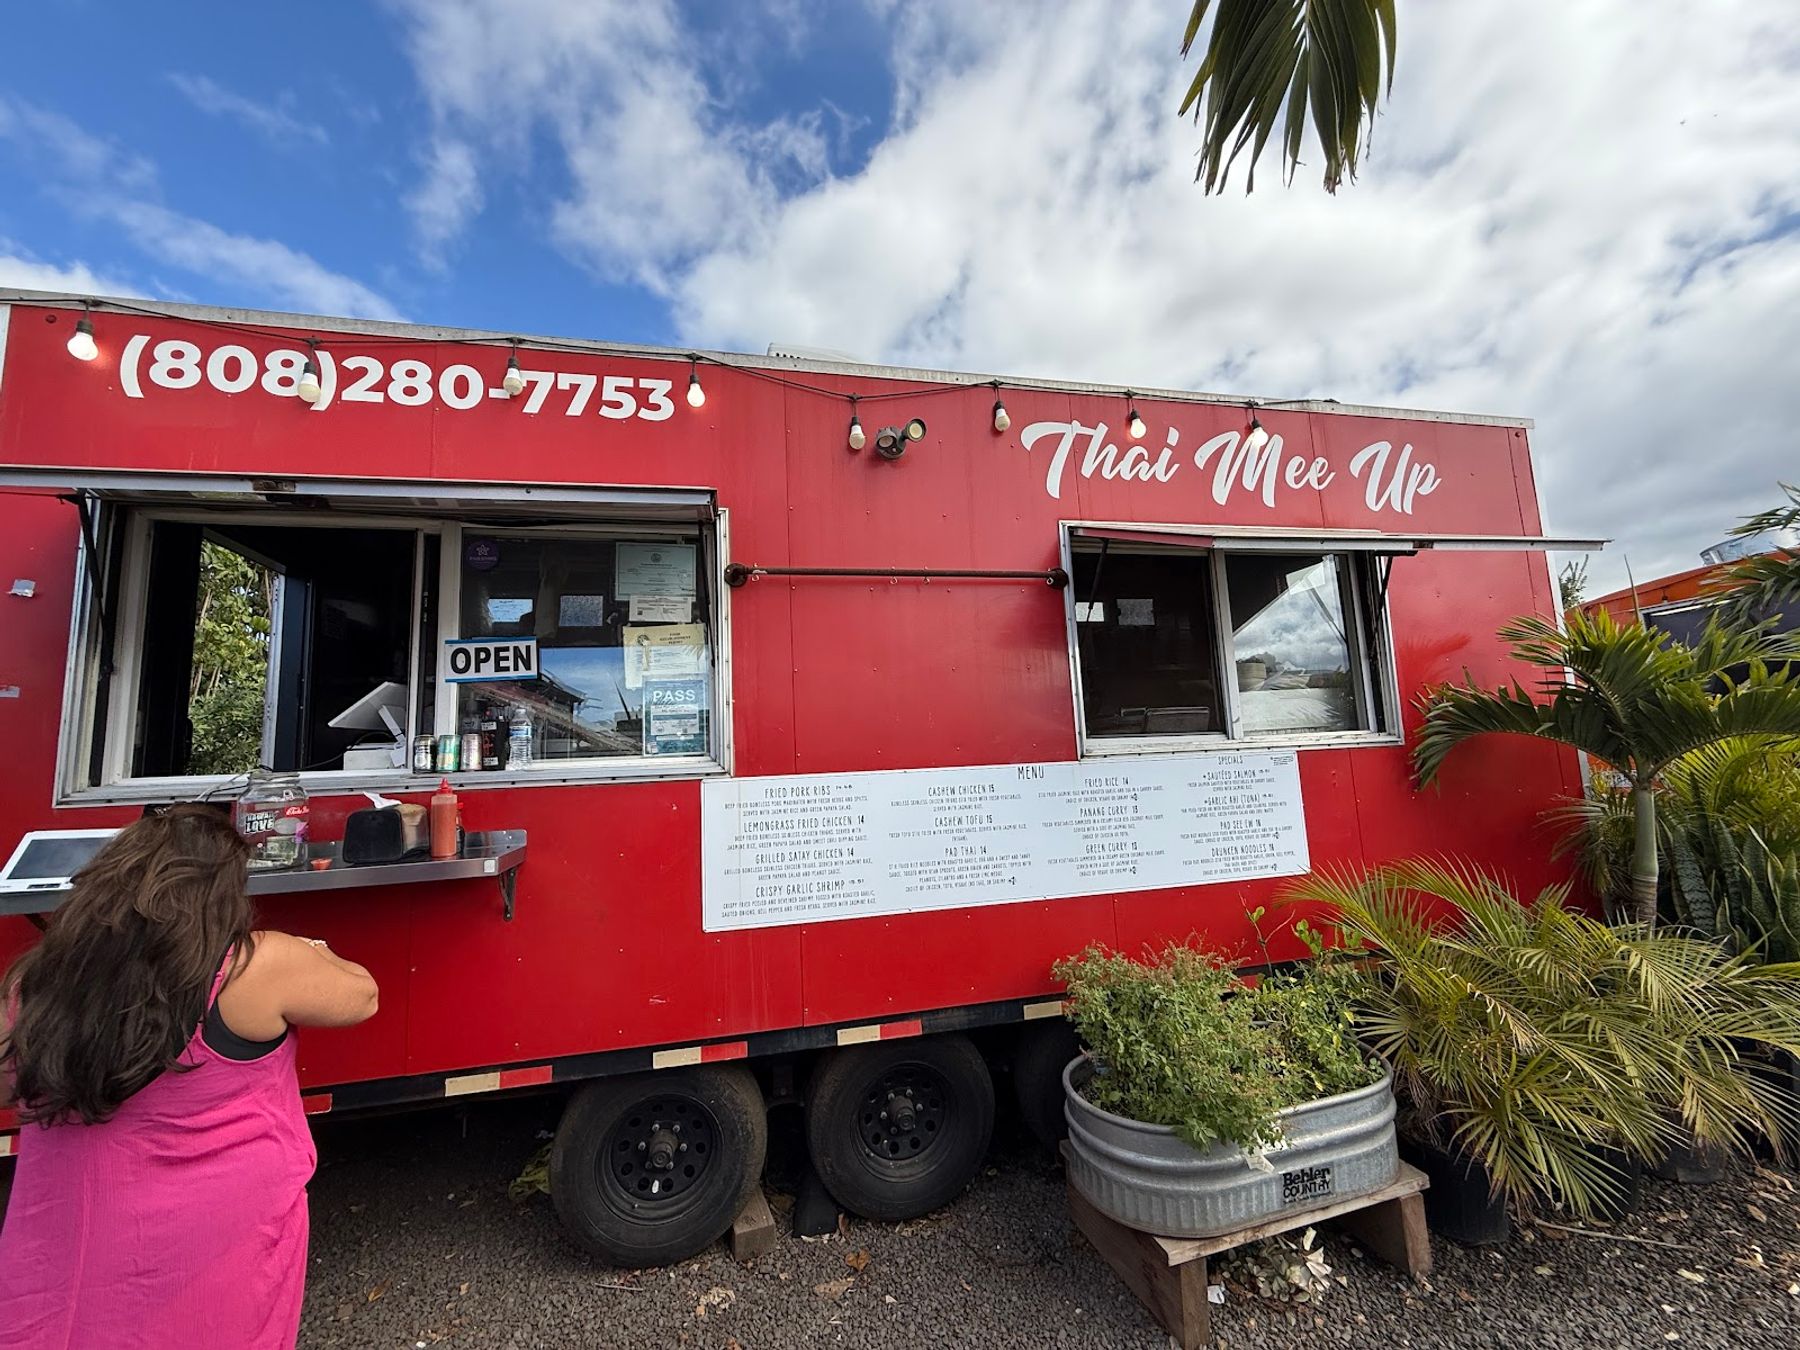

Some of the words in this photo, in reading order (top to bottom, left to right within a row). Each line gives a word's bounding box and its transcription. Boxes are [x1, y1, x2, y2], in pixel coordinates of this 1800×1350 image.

[119, 334, 676, 423] (808)280-7753
[1020, 420, 1180, 499] Thai
[1194, 429, 1336, 508] Mee
[1349, 440, 1442, 515] Up
[450, 645, 532, 675] OPEN
[653, 689, 696, 703] PASS
[1217, 755, 1243, 765] SPECIALS
[1017, 765, 1044, 779] MENU
[927, 785, 955, 796] CASHEW
[958, 784, 986, 795] CHICKEN
[988, 783, 994, 793] 15
[1084, 777, 1102, 788] FRIED
[1104, 776, 1118, 786] RICE
[764, 787, 787, 798] FRIED
[790, 786, 810, 797] PORK
[813, 785, 830, 796] RIBS
[246, 818, 275, 834] LOVE
[743, 819, 794, 832] LEMONGRASS
[797, 817, 819, 829] FRIED
[821, 815, 852, 827] CHICKEN
[857, 814, 864, 824] 14
[934, 815, 963, 827] CASHEW
[965, 814, 983, 825] TOFU
[986, 814, 992, 823] 15
[755, 852, 785, 864] GRILLED
[788, 850, 810, 861] SATAY
[813, 848, 843, 859] CHICKEN
[846, 847, 854, 857] 14
[944, 846, 957, 857] PAD
[960, 845, 976, 855] THAI
[979, 845, 986, 854] 14
[755, 885, 783, 897] CRISPY
[786, 882, 813, 895] GARLIC
[816, 879, 844, 892] SHRIMP
[1282, 1167, 1331, 1188] Behler
[1283, 1180, 1331, 1199] COUNTRY
